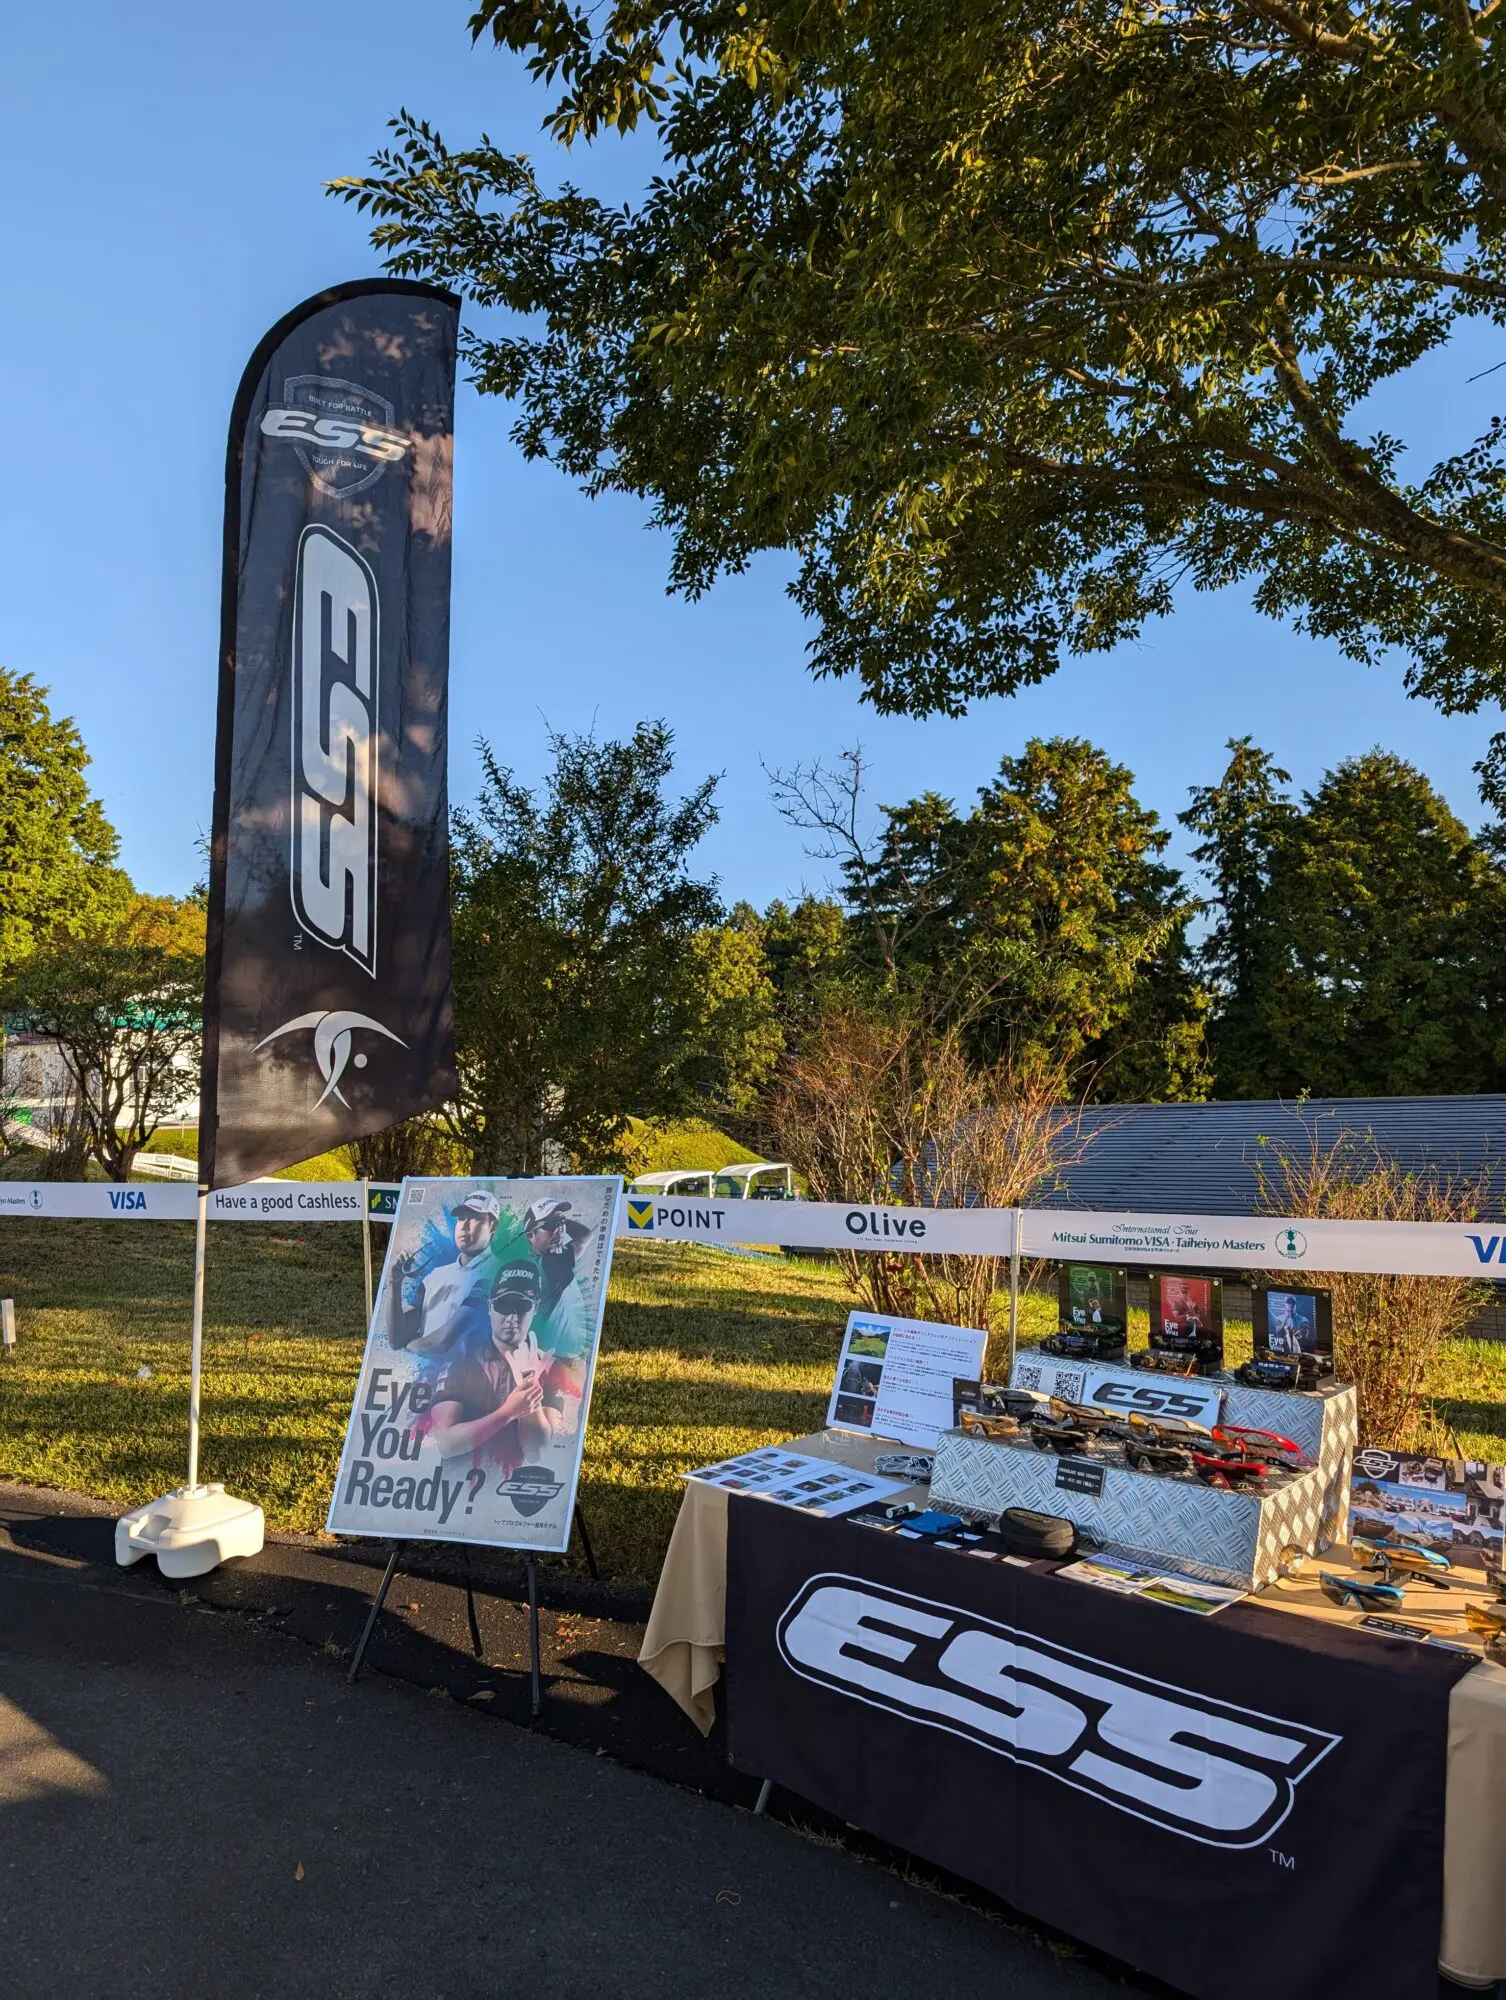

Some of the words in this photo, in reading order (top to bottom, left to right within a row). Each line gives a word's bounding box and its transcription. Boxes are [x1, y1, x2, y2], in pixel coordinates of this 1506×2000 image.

[308, 395, 326, 407] BUILT
[328, 401, 344, 409] FOR
[345, 404, 373, 417] BATTLE
[260, 409, 412, 461] ESS
[312, 455, 334, 465] TOUGH
[336, 459, 351, 467] FOR
[353, 461, 368, 471] LIFE
[301, 532, 370, 960] ESS
[106, 1191, 147, 1210] VISA
[215, 1194, 247, 1209] Have
[250, 1197, 258, 1209] a
[261, 1194, 294, 1213] good
[297, 1194, 361, 1209] Cashless.
[657, 1208, 726, 1229] POINT
[845, 1211, 926, 1238] Olive
[1112, 1223, 1171, 1235] International
[1173, 1224, 1199, 1235] Tour
[1052, 1232, 1087, 1244] Mitsui
[1089, 1233, 1143, 1246] Sumitomo
[1144, 1236, 1170, 1247] VISA
[1176, 1237, 1219, 1251] Taiheiyo
[1222, 1239, 1265, 1251] Masters
[501, 1268, 535, 1281] SRIXON
[1072, 1306, 1086, 1319] Eye
[1164, 1319, 1178, 1331] Eye
[1268, 1334, 1284, 1346] Eye
[365, 1367, 432, 1423] Eye
[1092, 1382, 1210, 1417] ESS
[360, 1413, 425, 1461] You
[1356, 1457, 1397, 1470] ESS
[344, 1459, 486, 1525] Ready?
[497, 1481, 563, 1498] ESS
[784, 1586, 1308, 1831] ESS
[1268, 1848, 1295, 1870] TM
